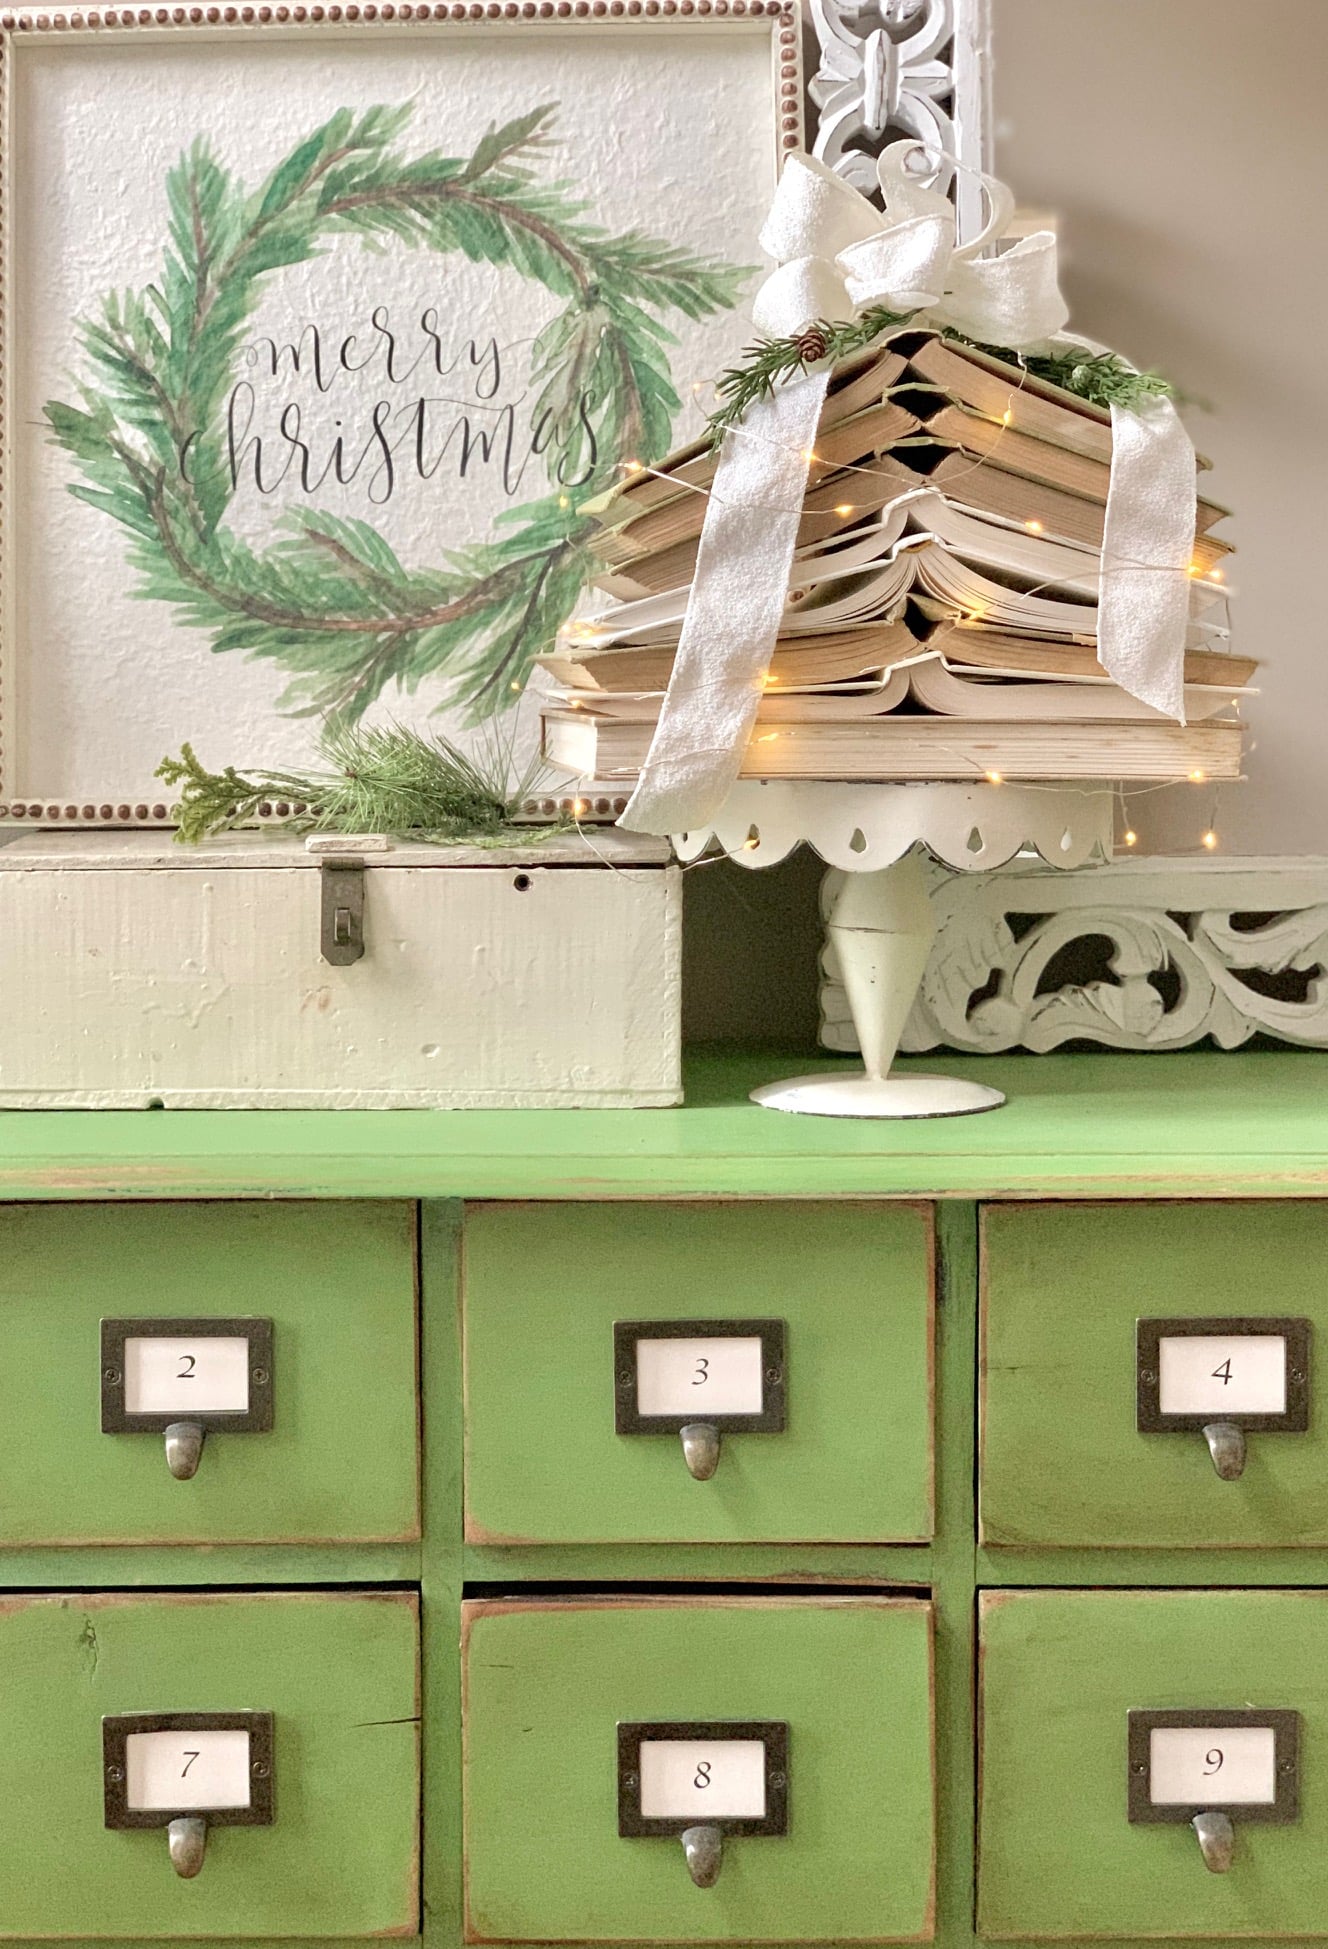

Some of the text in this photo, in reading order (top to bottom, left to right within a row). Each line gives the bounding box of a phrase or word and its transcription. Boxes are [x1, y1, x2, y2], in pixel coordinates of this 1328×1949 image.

[232, 305, 545, 400] merry
[180, 381, 598, 505] christmas
[176, 1355, 196, 1378] 2
[691, 1358, 709, 1385] 3
[1211, 1358, 1233, 1385] 4
[181, 1751, 200, 1778] 7
[693, 1761, 712, 1789] 8
[1203, 1748, 1224, 1776] 9
